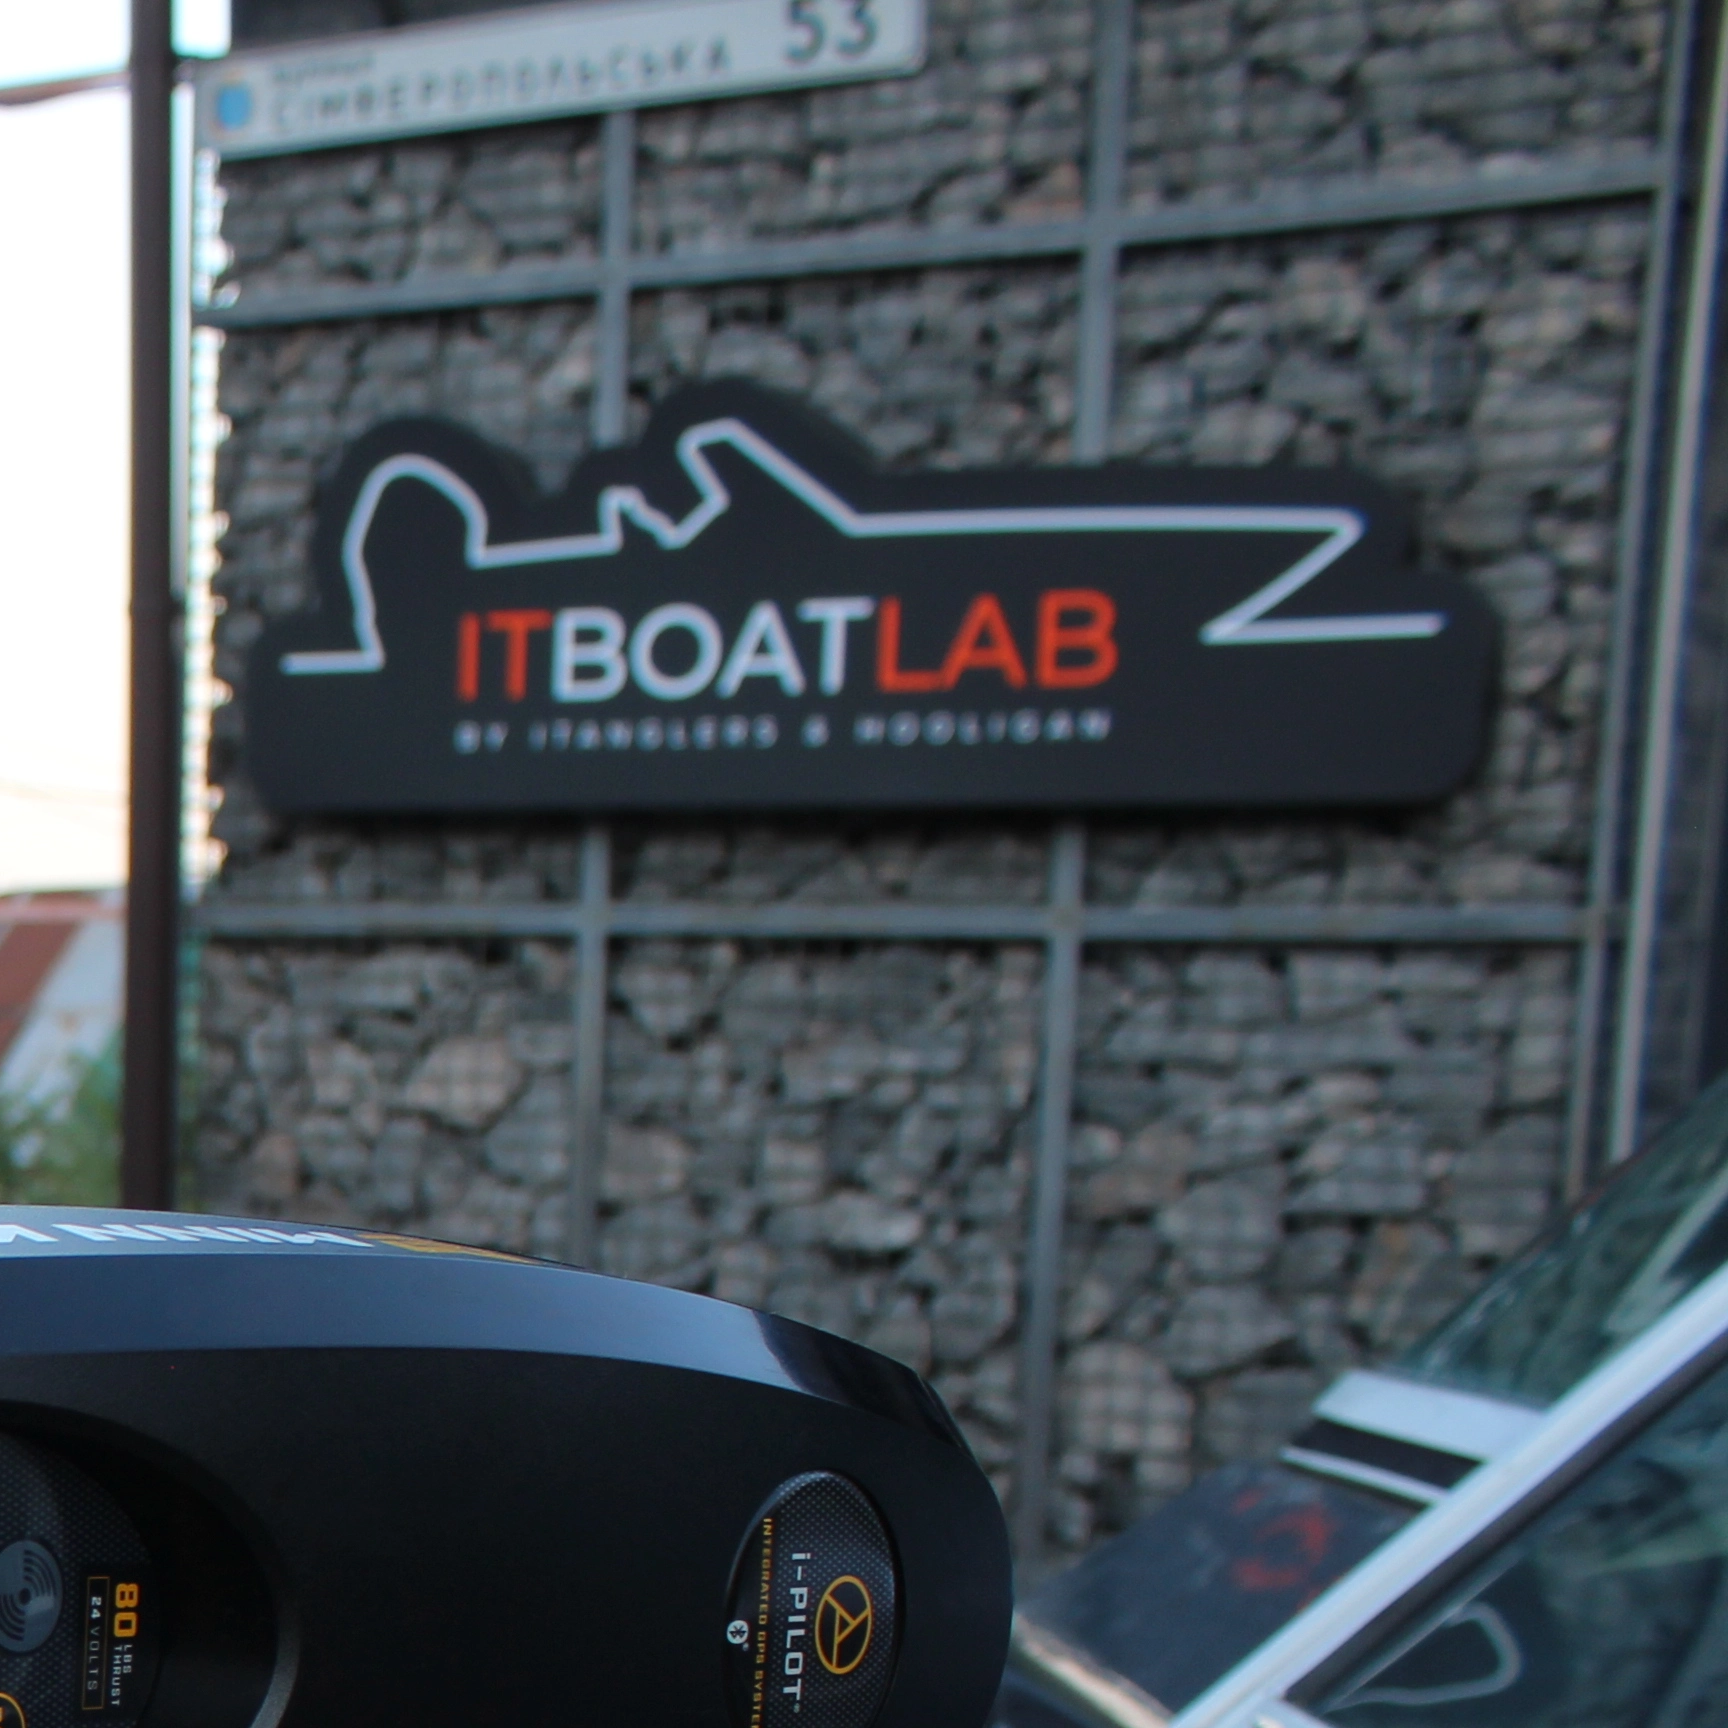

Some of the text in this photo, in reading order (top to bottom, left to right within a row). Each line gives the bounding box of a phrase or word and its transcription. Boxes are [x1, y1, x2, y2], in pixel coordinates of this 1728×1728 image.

[784, 0, 880, 62] 53
[457, 588, 1120, 704] ITBOATLAB
[453, 718, 509, 755] BY
[51, 1223, 376, 1248] MINN
[757, 1517, 773, 1626] INTEGRATED
[87, 1596, 102, 1691] 24 VOLTS
[113, 1582, 140, 1674] 80 LBS
[755, 1630, 766, 1665] GPS
[110, 1644, 124, 1706] THRUST
